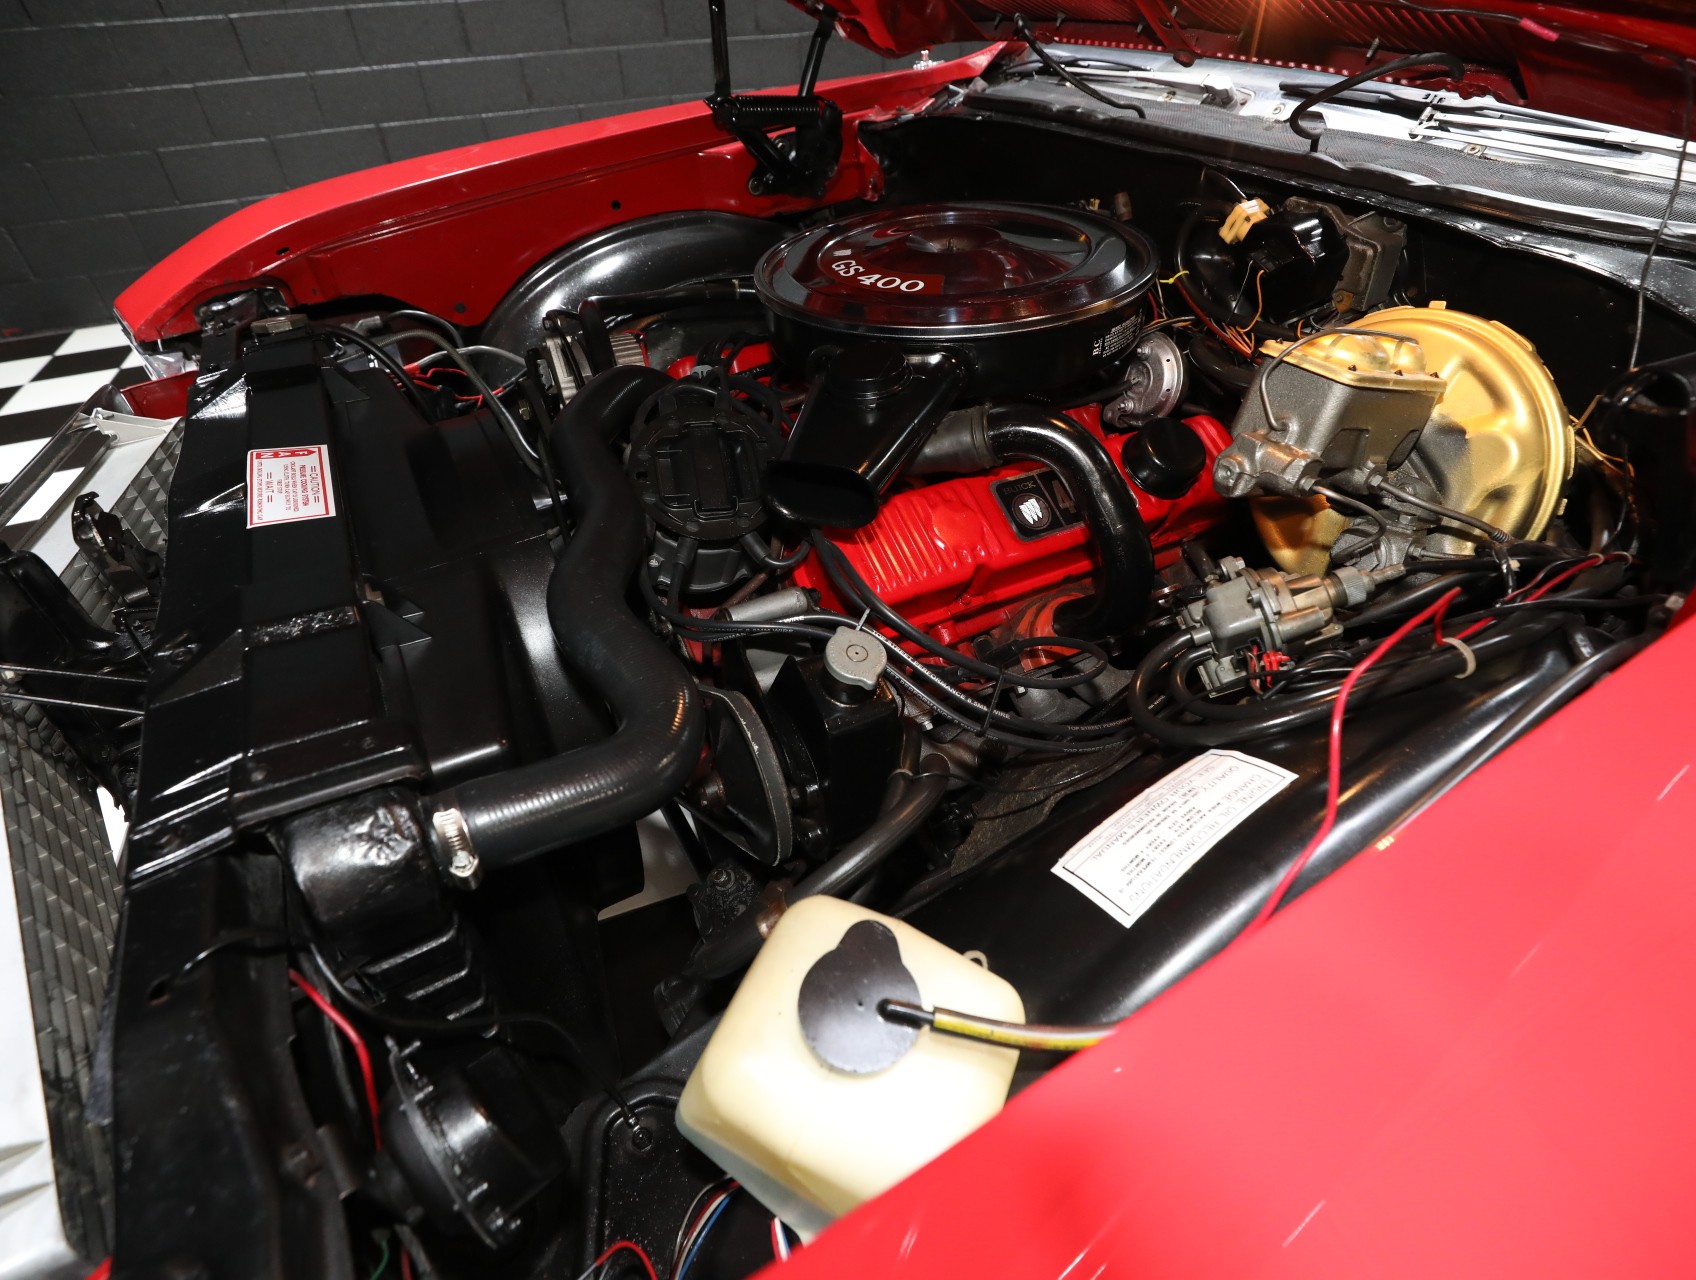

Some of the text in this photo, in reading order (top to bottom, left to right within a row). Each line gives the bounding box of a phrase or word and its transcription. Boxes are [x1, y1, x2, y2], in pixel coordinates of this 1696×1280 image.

[831, 259, 925, 292] GS 400
[265, 480, 274, 494] WAIT
[310, 473, 321, 496] CAUTION
[914, 659, 967, 701] PERFORMANCE
[1201, 764, 1239, 793] QUALITY
[1221, 773, 1261, 802] CHANGE
[1237, 776, 1272, 807] ENGINE
[1219, 804, 1237, 821] OIL
[1090, 830, 1127, 862] MANUAL
[1127, 819, 1220, 902] RECOMMENDATIONS
